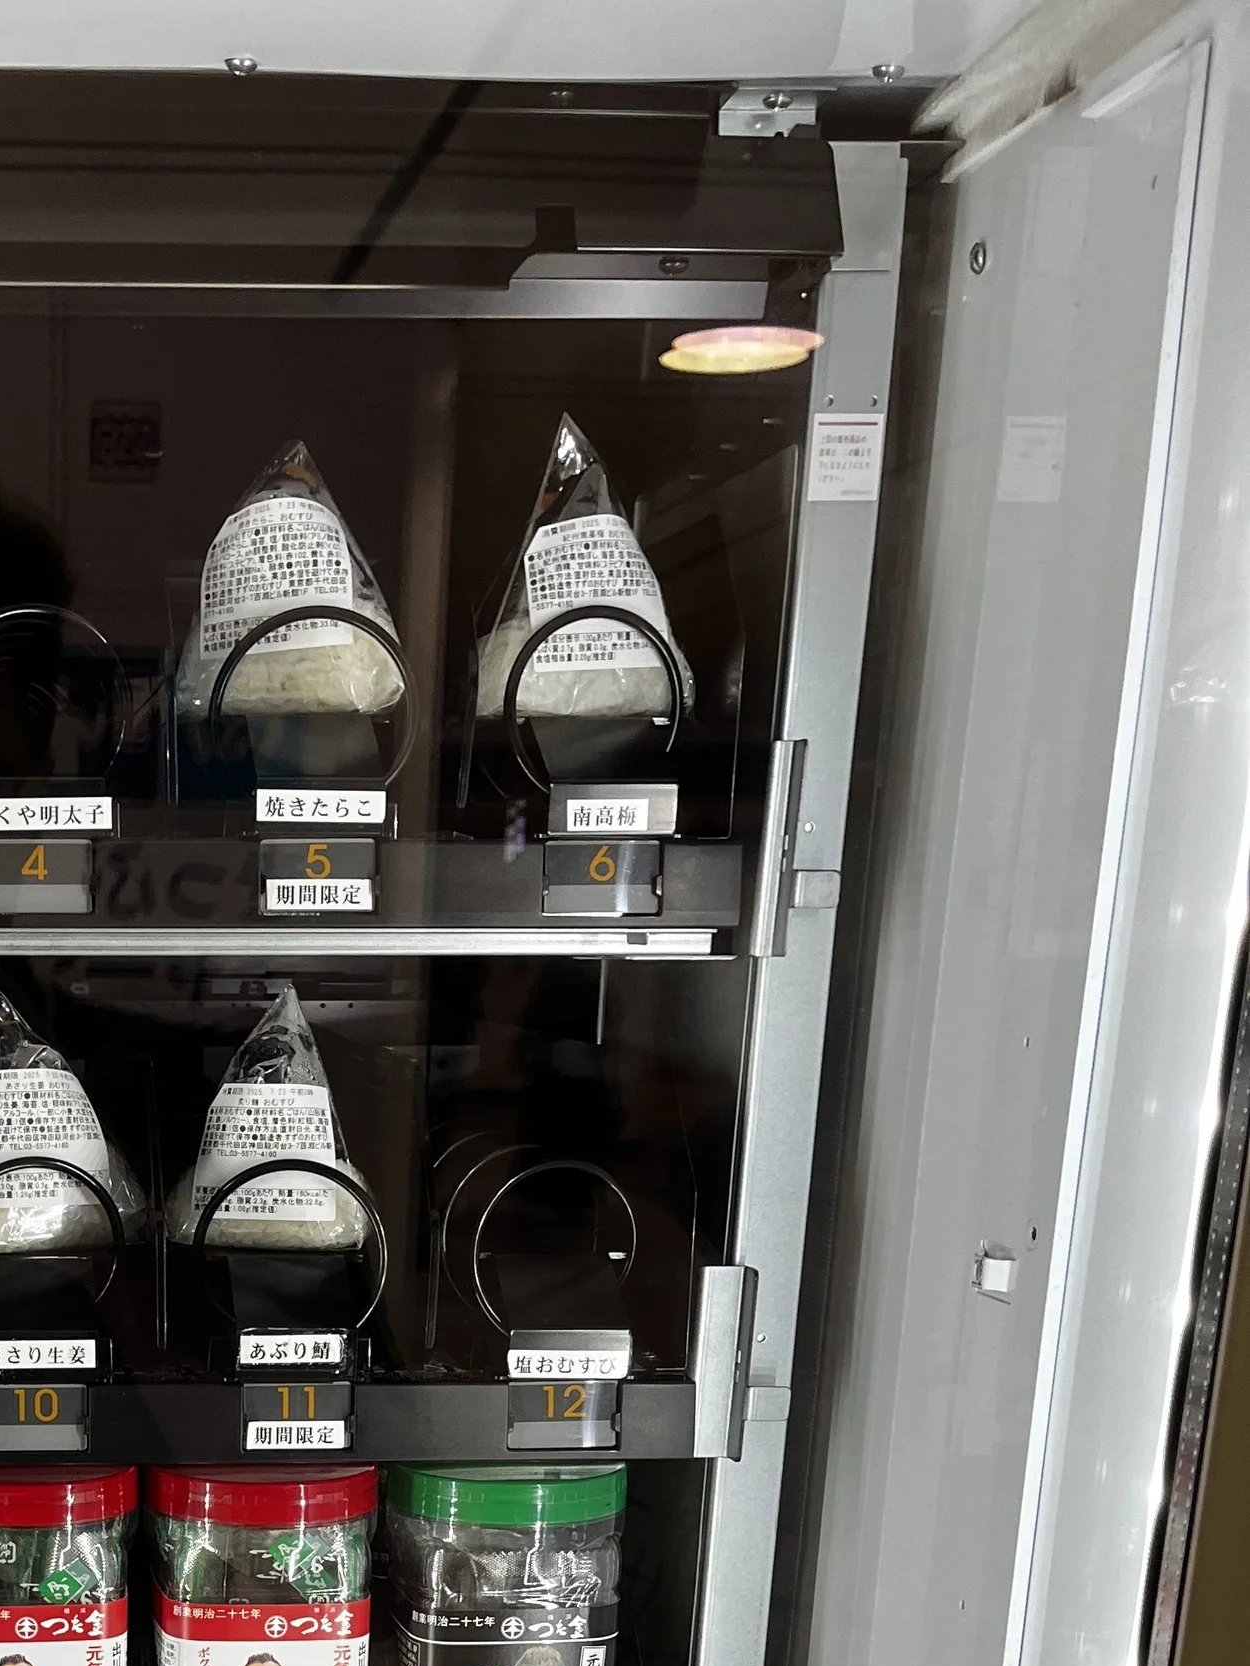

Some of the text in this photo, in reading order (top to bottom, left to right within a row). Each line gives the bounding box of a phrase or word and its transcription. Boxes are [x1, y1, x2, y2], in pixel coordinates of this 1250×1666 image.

[264, 795, 372, 820] 焼きたらこ
[573, 806, 638, 827] 南高梅
[21, 845, 48, 881] 4
[306, 844, 331, 879] 5
[589, 845, 616, 882] 6
[276, 884, 361, 906] 期間限定
[250, 1340, 331, 1360] あぶり鯖
[514, 1355, 617, 1375] 塩おむすび
[14, 1388, 60, 1423] 10
[277, 1387, 316, 1419] 11
[542, 1386, 587, 1418] 12
[254, 1426, 335, 1446] 期間限定
[173, 1605, 261, 1619] 創業明治二十七年
[412, 1610, 496, 1627] 創業明治二十七年
